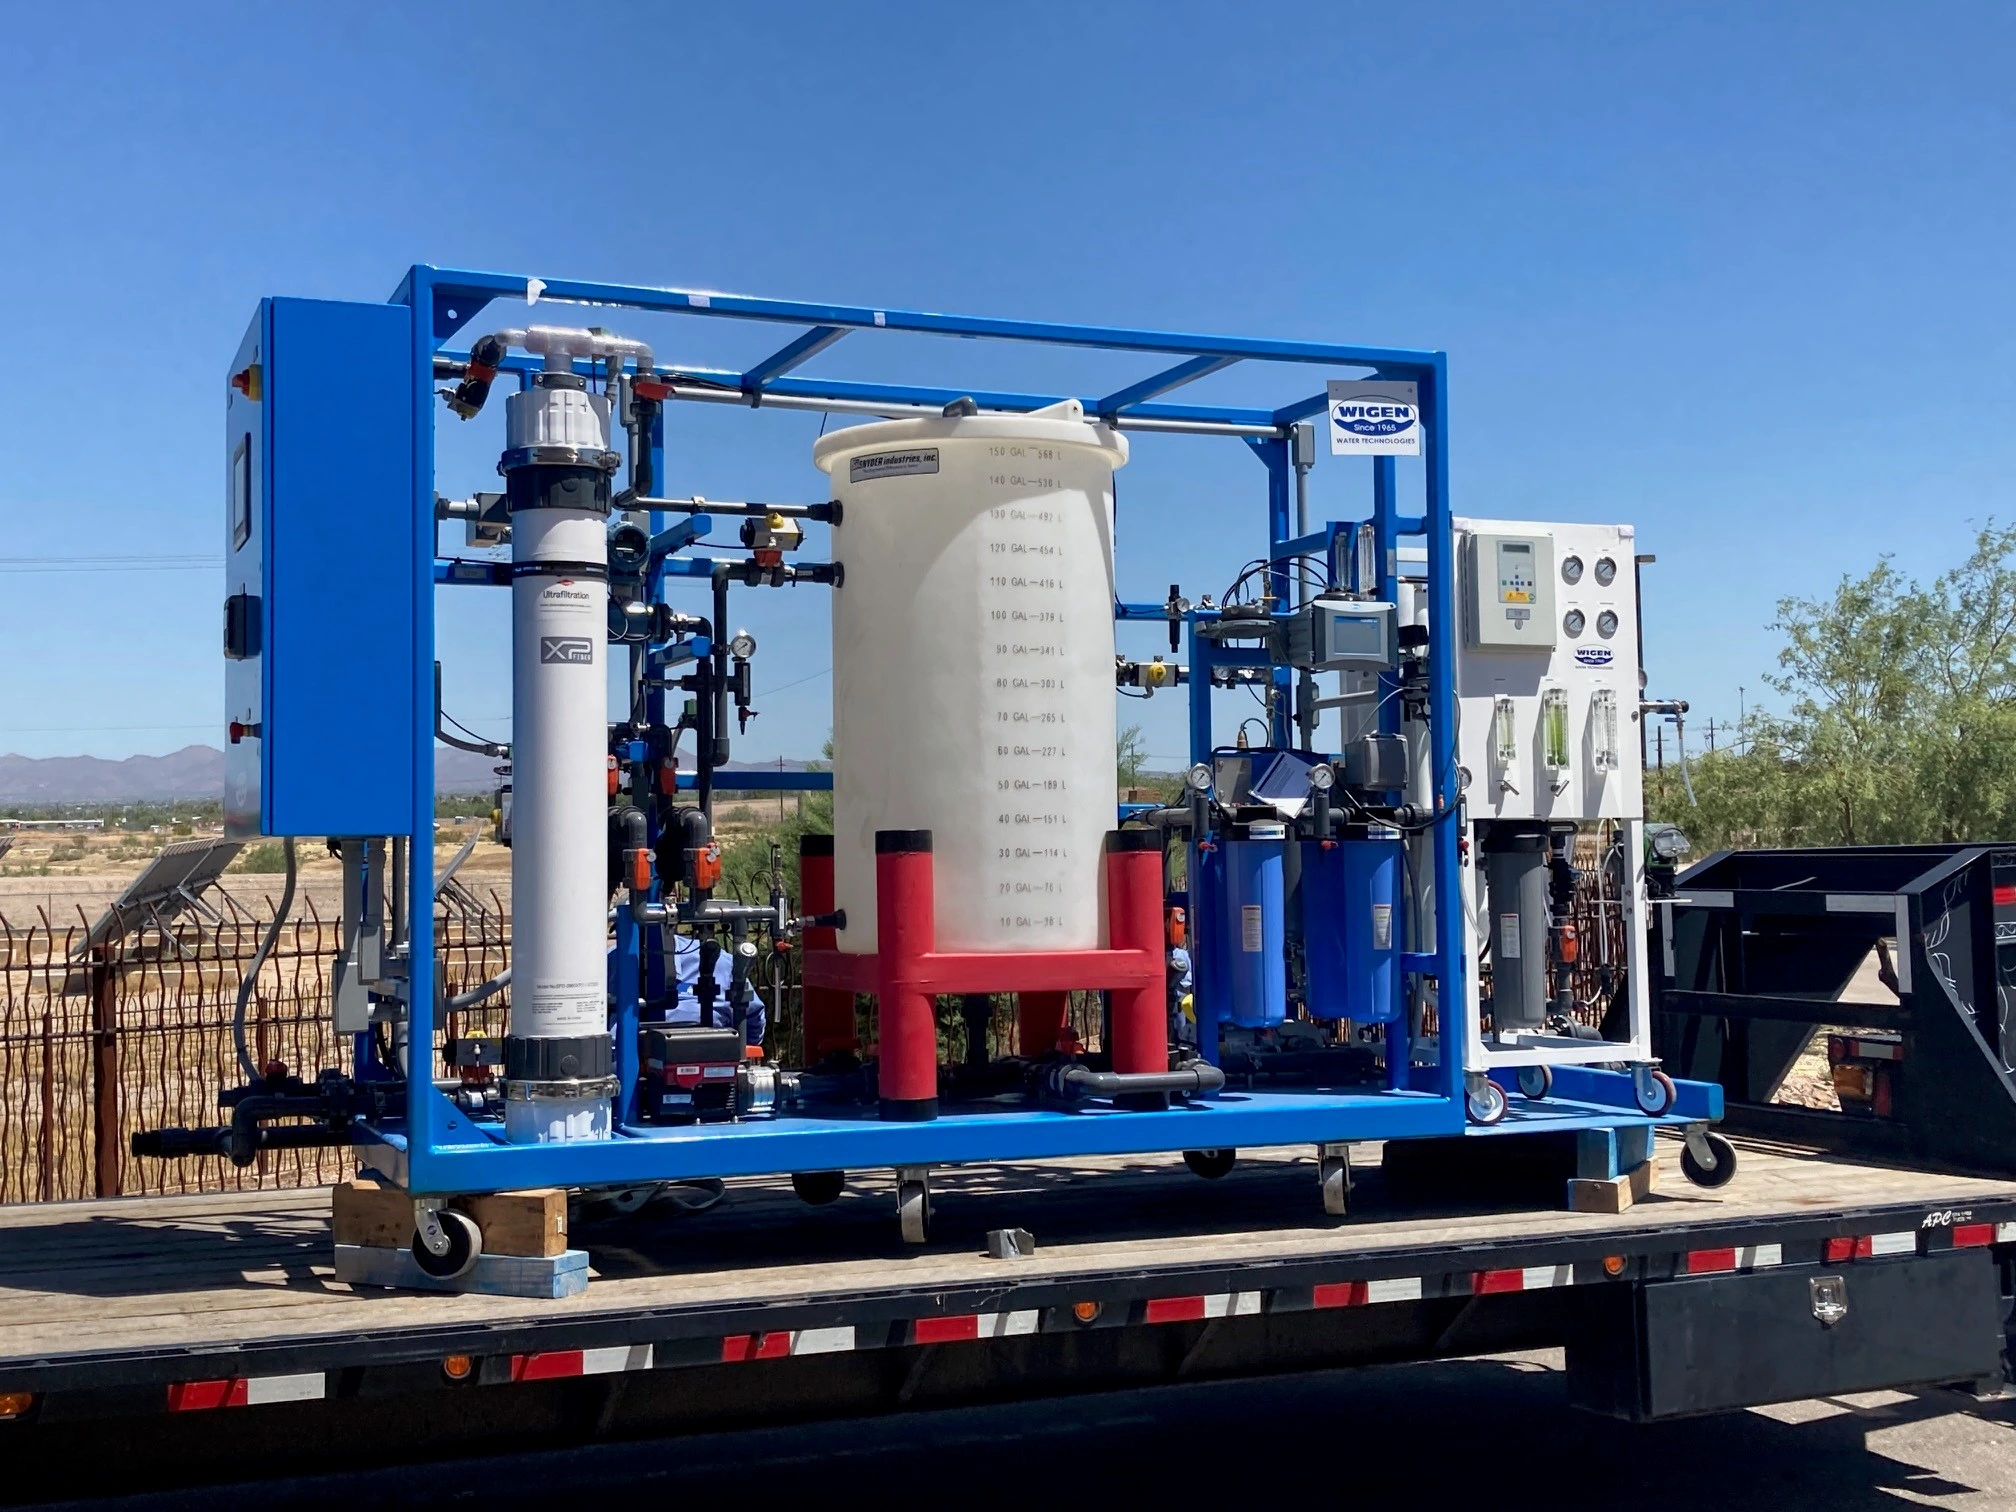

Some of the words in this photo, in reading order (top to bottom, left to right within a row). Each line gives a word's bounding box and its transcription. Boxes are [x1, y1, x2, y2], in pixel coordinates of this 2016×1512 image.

[1338, 406, 1410, 418] WIGEN
[1353, 424, 1375, 432] Since
[1377, 424, 1397, 432] 1965
[989, 447, 1005, 456] 150
[989, 475, 1005, 485] 140
[990, 509, 1005, 519] 130
[990, 543, 1006, 553] 120
[990, 577, 1006, 586] 110
[543, 590, 590, 600] Ultrafiltration
[991, 611, 1007, 620] 100
[996, 645, 1007, 654] 90
[1577, 649, 1612, 657] WIGEN
[996, 678, 1007, 688] 80
[997, 712, 1008, 722] 70
[997, 746, 1009, 756] 60
[998, 780, 1009, 789] 50
[998, 814, 1010, 824] 40
[999, 848, 1010, 858] 30
[1921, 1210, 1952, 1229] APC
